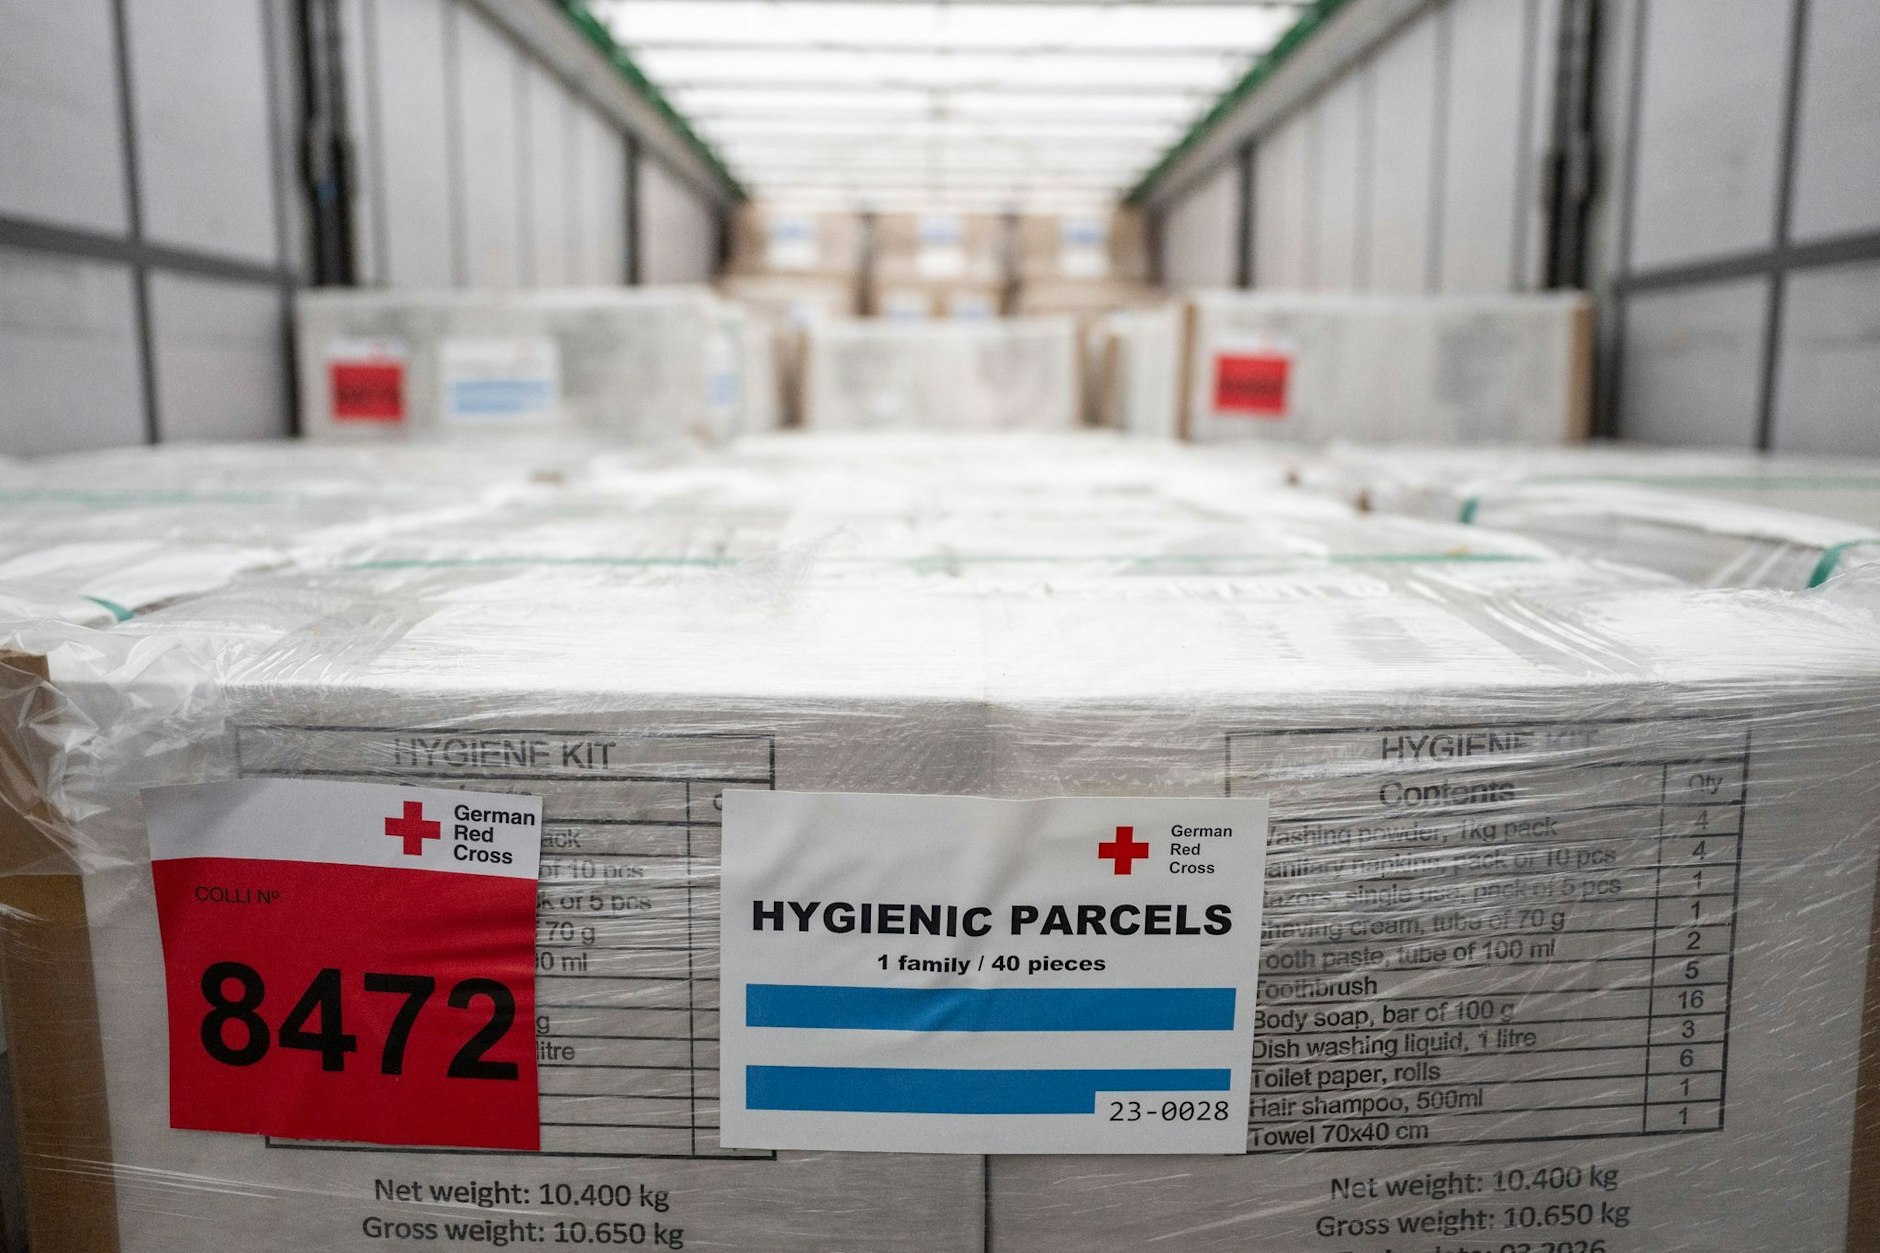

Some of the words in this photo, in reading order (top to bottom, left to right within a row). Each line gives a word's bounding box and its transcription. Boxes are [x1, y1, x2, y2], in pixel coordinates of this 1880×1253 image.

[394, 738, 549, 768] HYGIENE
[562, 741, 616, 769] KIT
[1382, 731, 1535, 762] HYGIENE
[1379, 779, 1516, 808] Contents
[1688, 773, 1723, 794] Qty
[454, 804, 535, 825] German
[1695, 810, 1709, 830] 4
[454, 824, 494, 842] Red
[541, 829, 582, 848] ack
[1171, 824, 1233, 837] German
[1461, 818, 1497, 841] 1kg
[1503, 817, 1559, 843] pack
[453, 844, 513, 864] Cross
[1170, 843, 1201, 856] Red
[1546, 848, 1570, 867] 10
[1577, 847, 1617, 868] pcs
[1692, 841, 1706, 859] 4
[568, 859, 595, 879] 10
[603, 862, 645, 884] pcs
[1169, 861, 1215, 874] Cross
[1562, 879, 1575, 897] 5
[1583, 878, 1622, 900] pcs
[1693, 871, 1702, 889] 1
[195, 886, 250, 904] COLLI
[590, 893, 604, 911] 5
[611, 895, 652, 915] pcs
[753, 900, 992, 937] HYGIENIC
[1010, 904, 1233, 935] PARCELS
[1691, 901, 1700, 920] 1
[1351, 913, 1425, 935] cream,
[1517, 908, 1545, 928] 70
[1551, 912, 1565, 931] g
[546, 921, 575, 941] 70
[581, 927, 596, 945] g
[1687, 931, 1700, 950] 2
[561, 952, 588, 972] ml
[877, 954, 888, 970] 1
[898, 955, 971, 975] family
[977, 955, 985, 972] /
[991, 955, 1020, 971] 40
[1028, 955, 1106, 975] pieces
[1323, 947, 1390, 972] paste,
[1398, 943, 1447, 965] tube
[1453, 941, 1477, 961] of
[1482, 939, 1523, 960] 100
[1530, 938, 1556, 959] ml
[1684, 961, 1699, 979] 5
[1678, 990, 1704, 1009] 16
[201, 961, 519, 1081] 8472
[536, 1015, 550, 1035] g
[1254, 1010, 1308, 1032] Body
[1314, 1009, 1374, 1030] soap,
[1383, 1004, 1420, 1024] bar
[1425, 1002, 1449, 1021] of
[1457, 1001, 1494, 1020] 100
[1501, 1003, 1515, 1023] g
[1682, 1020, 1695, 1038] 3
[1253, 1039, 1300, 1059] Dish
[1306, 1035, 1398, 1057] washing
[1405, 1031, 1468, 1055] liquid,
[1478, 1031, 1487, 1049] 1
[1497, 1029, 1537, 1048] litre
[1680, 1049, 1694, 1067] 6
[1252, 1068, 1312, 1088] Toilet
[1318, 1067, 1388, 1088] paper,
[1394, 1062, 1441, 1081] rolls
[1680, 1078, 1689, 1096] 1
[1109, 1100, 1229, 1121] 23-0028
[1251, 1098, 1297, 1117] Hair
[1302, 1095, 1409, 1117] shampoo,
[1416, 1088, 1483, 1110] 500ml
[1678, 1107, 1688, 1125] 1
[1249, 1126, 1315, 1146] Towel
[1322, 1122, 1390, 1143] 70x40
[1396, 1124, 1429, 1140] cm
[1331, 1177, 1378, 1200] Net
[1386, 1171, 1484, 1200] weight:
[1493, 1166, 1582, 1191] 10.400
[1589, 1164, 1620, 1191] kg
[375, 1179, 423, 1202] Net
[430, 1180, 530, 1208] weight:
[539, 1183, 631, 1207] 10.400
[640, 1184, 670, 1212] kg
[1316, 1215, 1390, 1238] Gross
[1398, 1209, 1496, 1236] weight:
[1504, 1204, 1594, 1229] 10.650
[1600, 1201, 1631, 1228] kg
[362, 1216, 438, 1240] Gross
[444, 1219, 545, 1246] weight:
[554, 1221, 646, 1245] 10.650
[654, 1222, 684, 1249] kg
